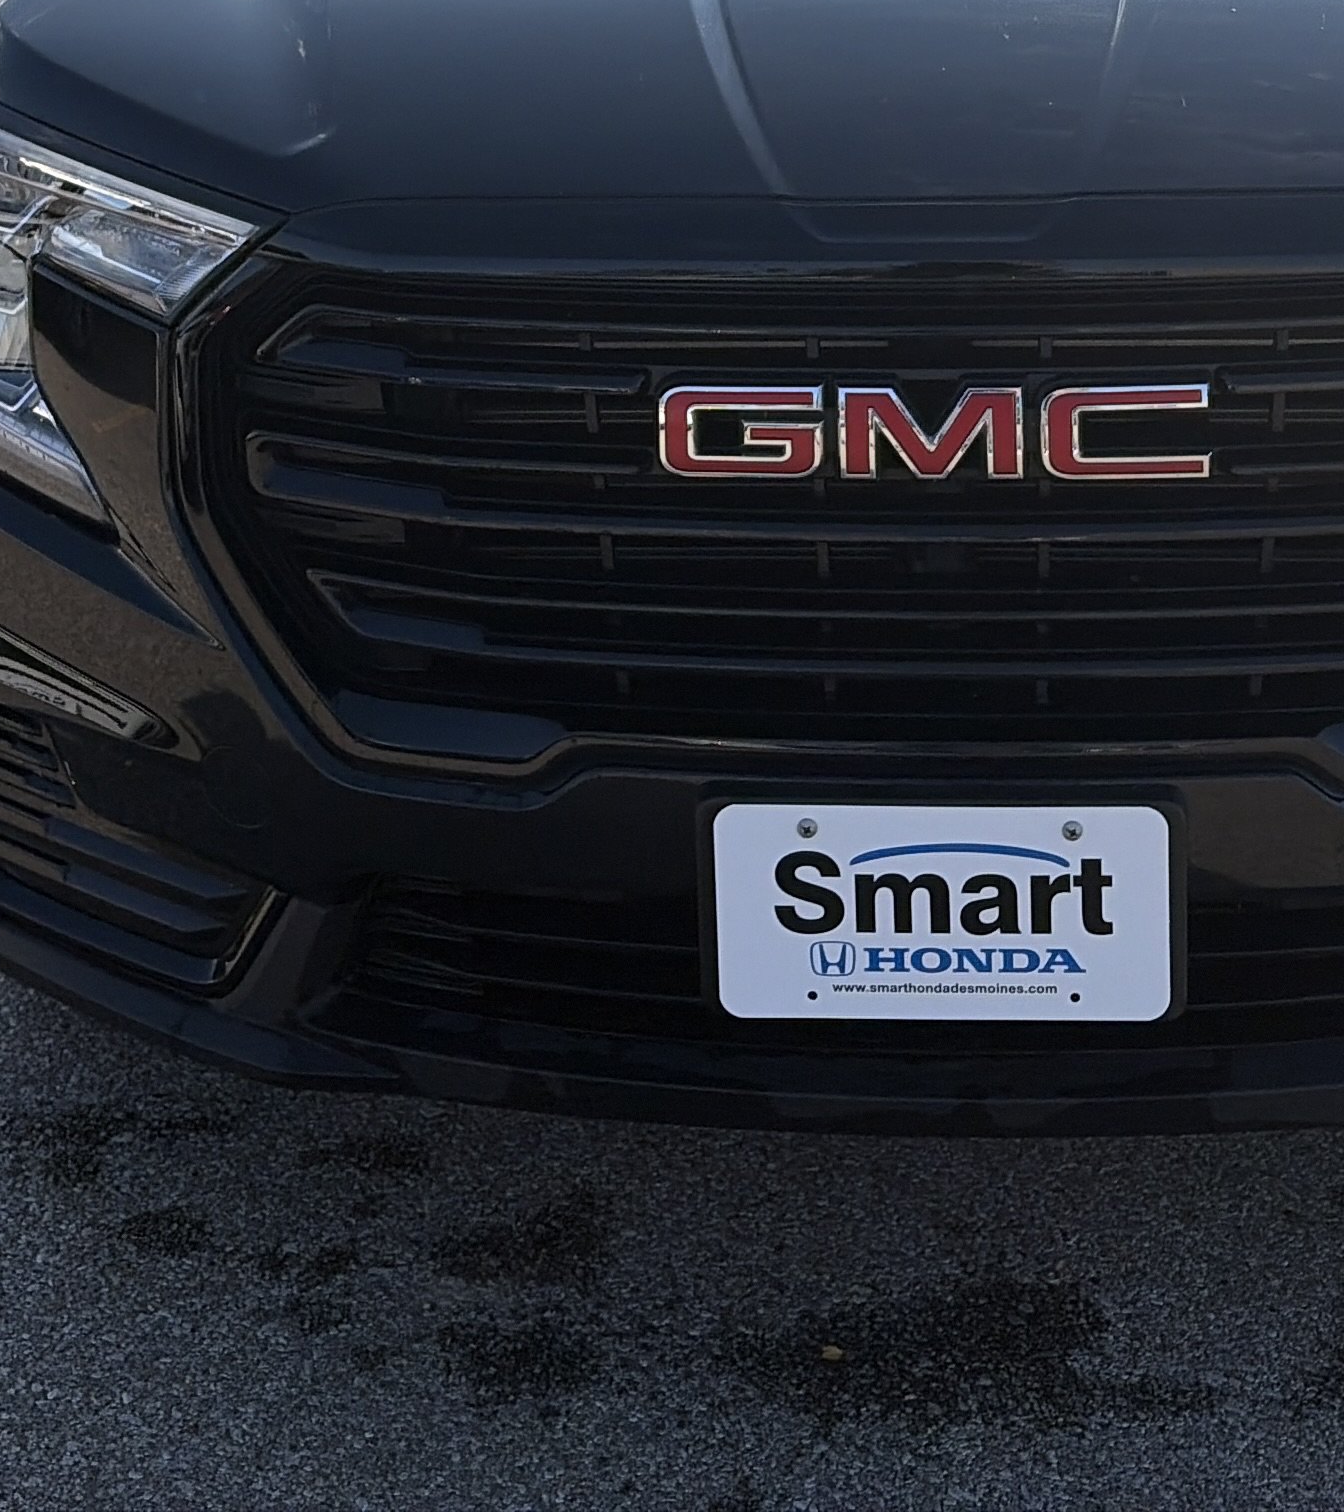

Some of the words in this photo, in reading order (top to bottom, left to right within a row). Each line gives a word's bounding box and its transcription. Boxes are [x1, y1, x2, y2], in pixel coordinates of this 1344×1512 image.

[659, 384, 1211, 479] GMC
[773, 850, 1114, 935] Smart
[832, 982, 1058, 995] www.smarthondadesmoines.com
[864, 947, 1086, 974] HONDA
